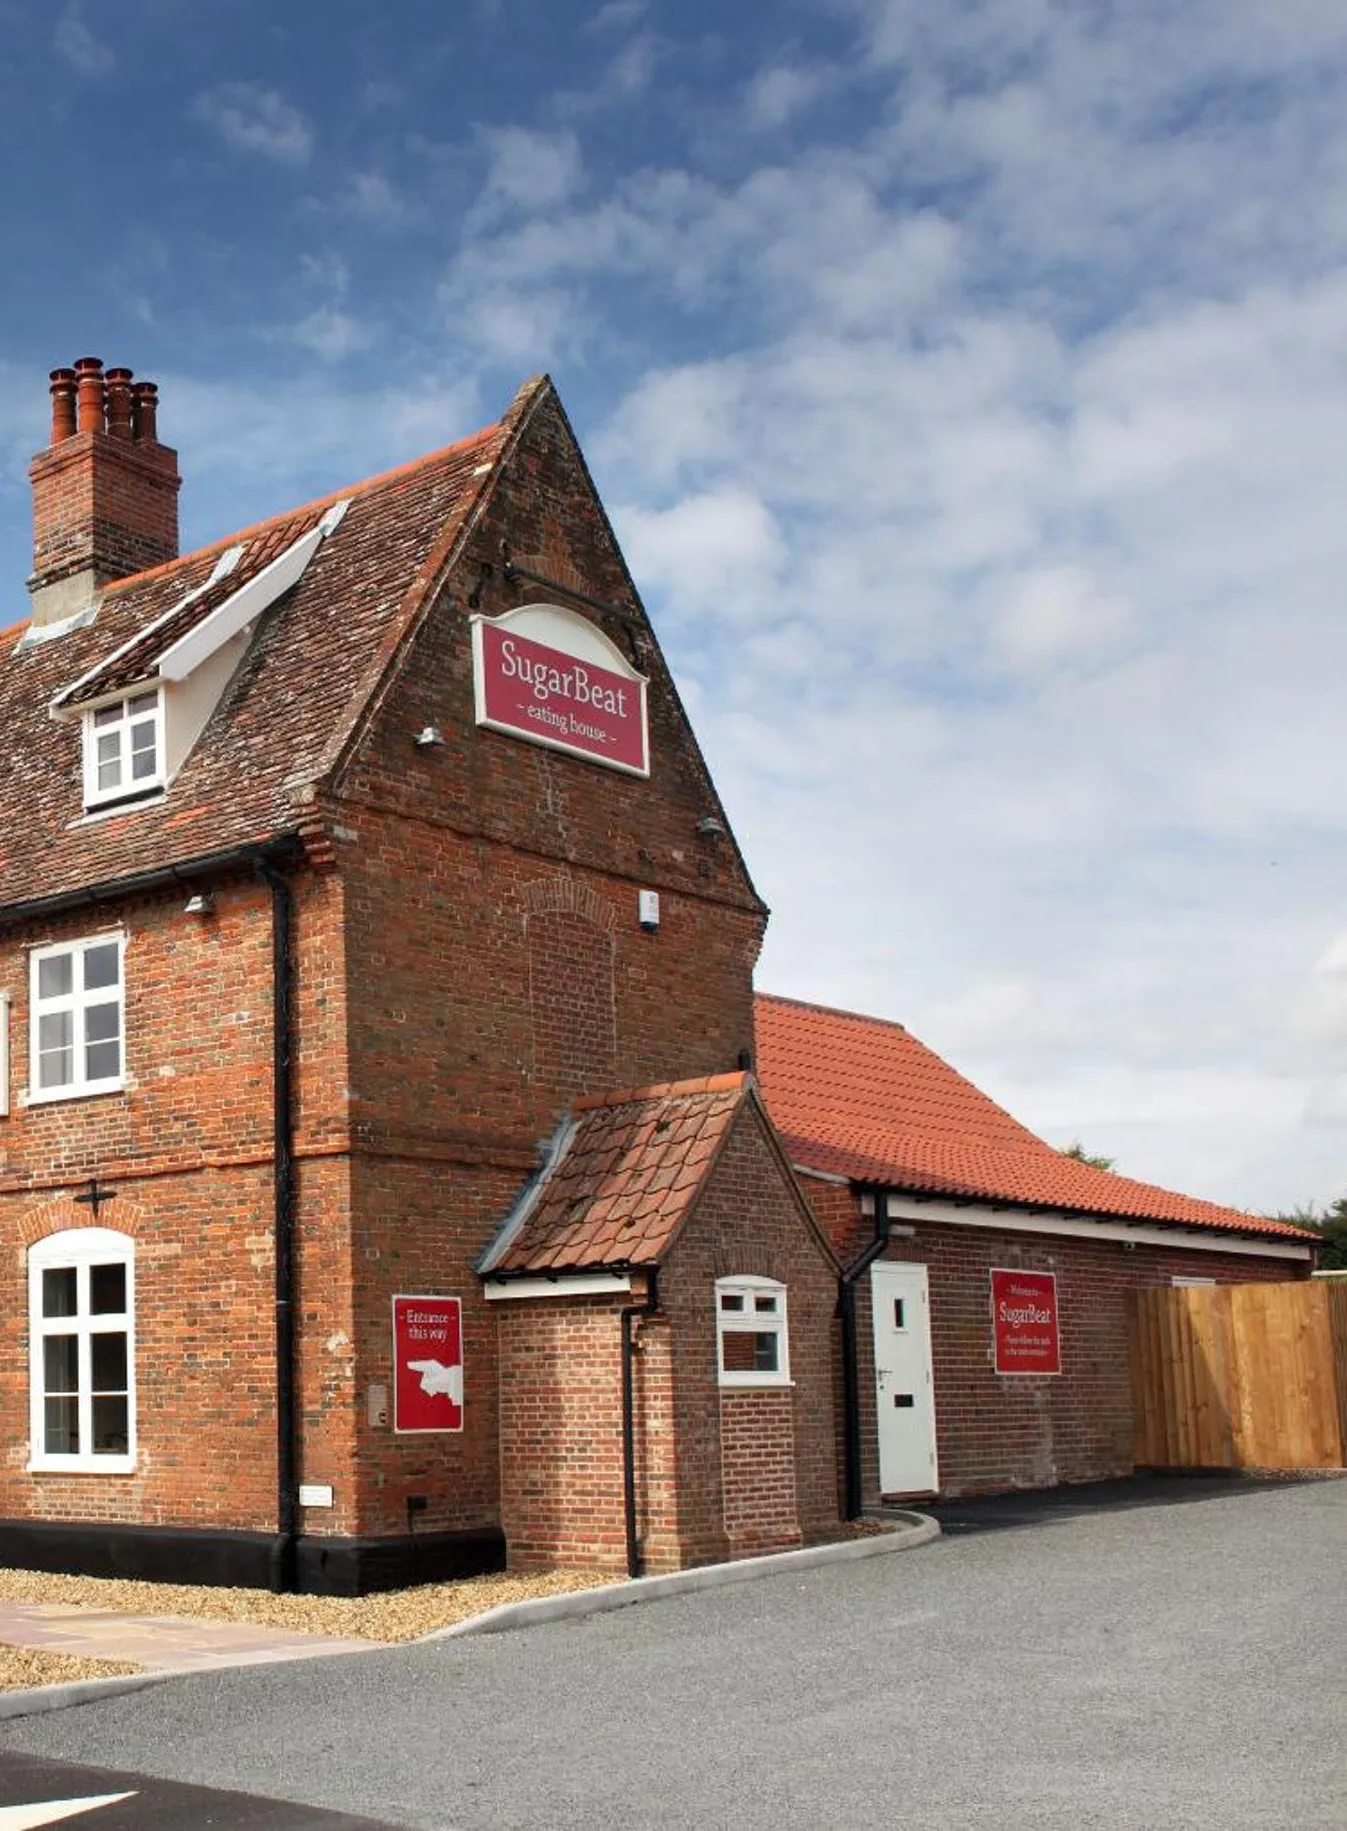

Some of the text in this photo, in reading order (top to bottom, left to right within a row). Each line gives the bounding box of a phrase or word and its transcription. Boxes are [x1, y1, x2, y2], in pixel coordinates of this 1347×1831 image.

[501, 640, 628, 718] SugarBeat
[527, 704, 607, 743] eating house
[406, 1309, 449, 1324] Entrance
[999, 1301, 1052, 1329] SugarBeat
[409, 1324, 448, 1344] this way
